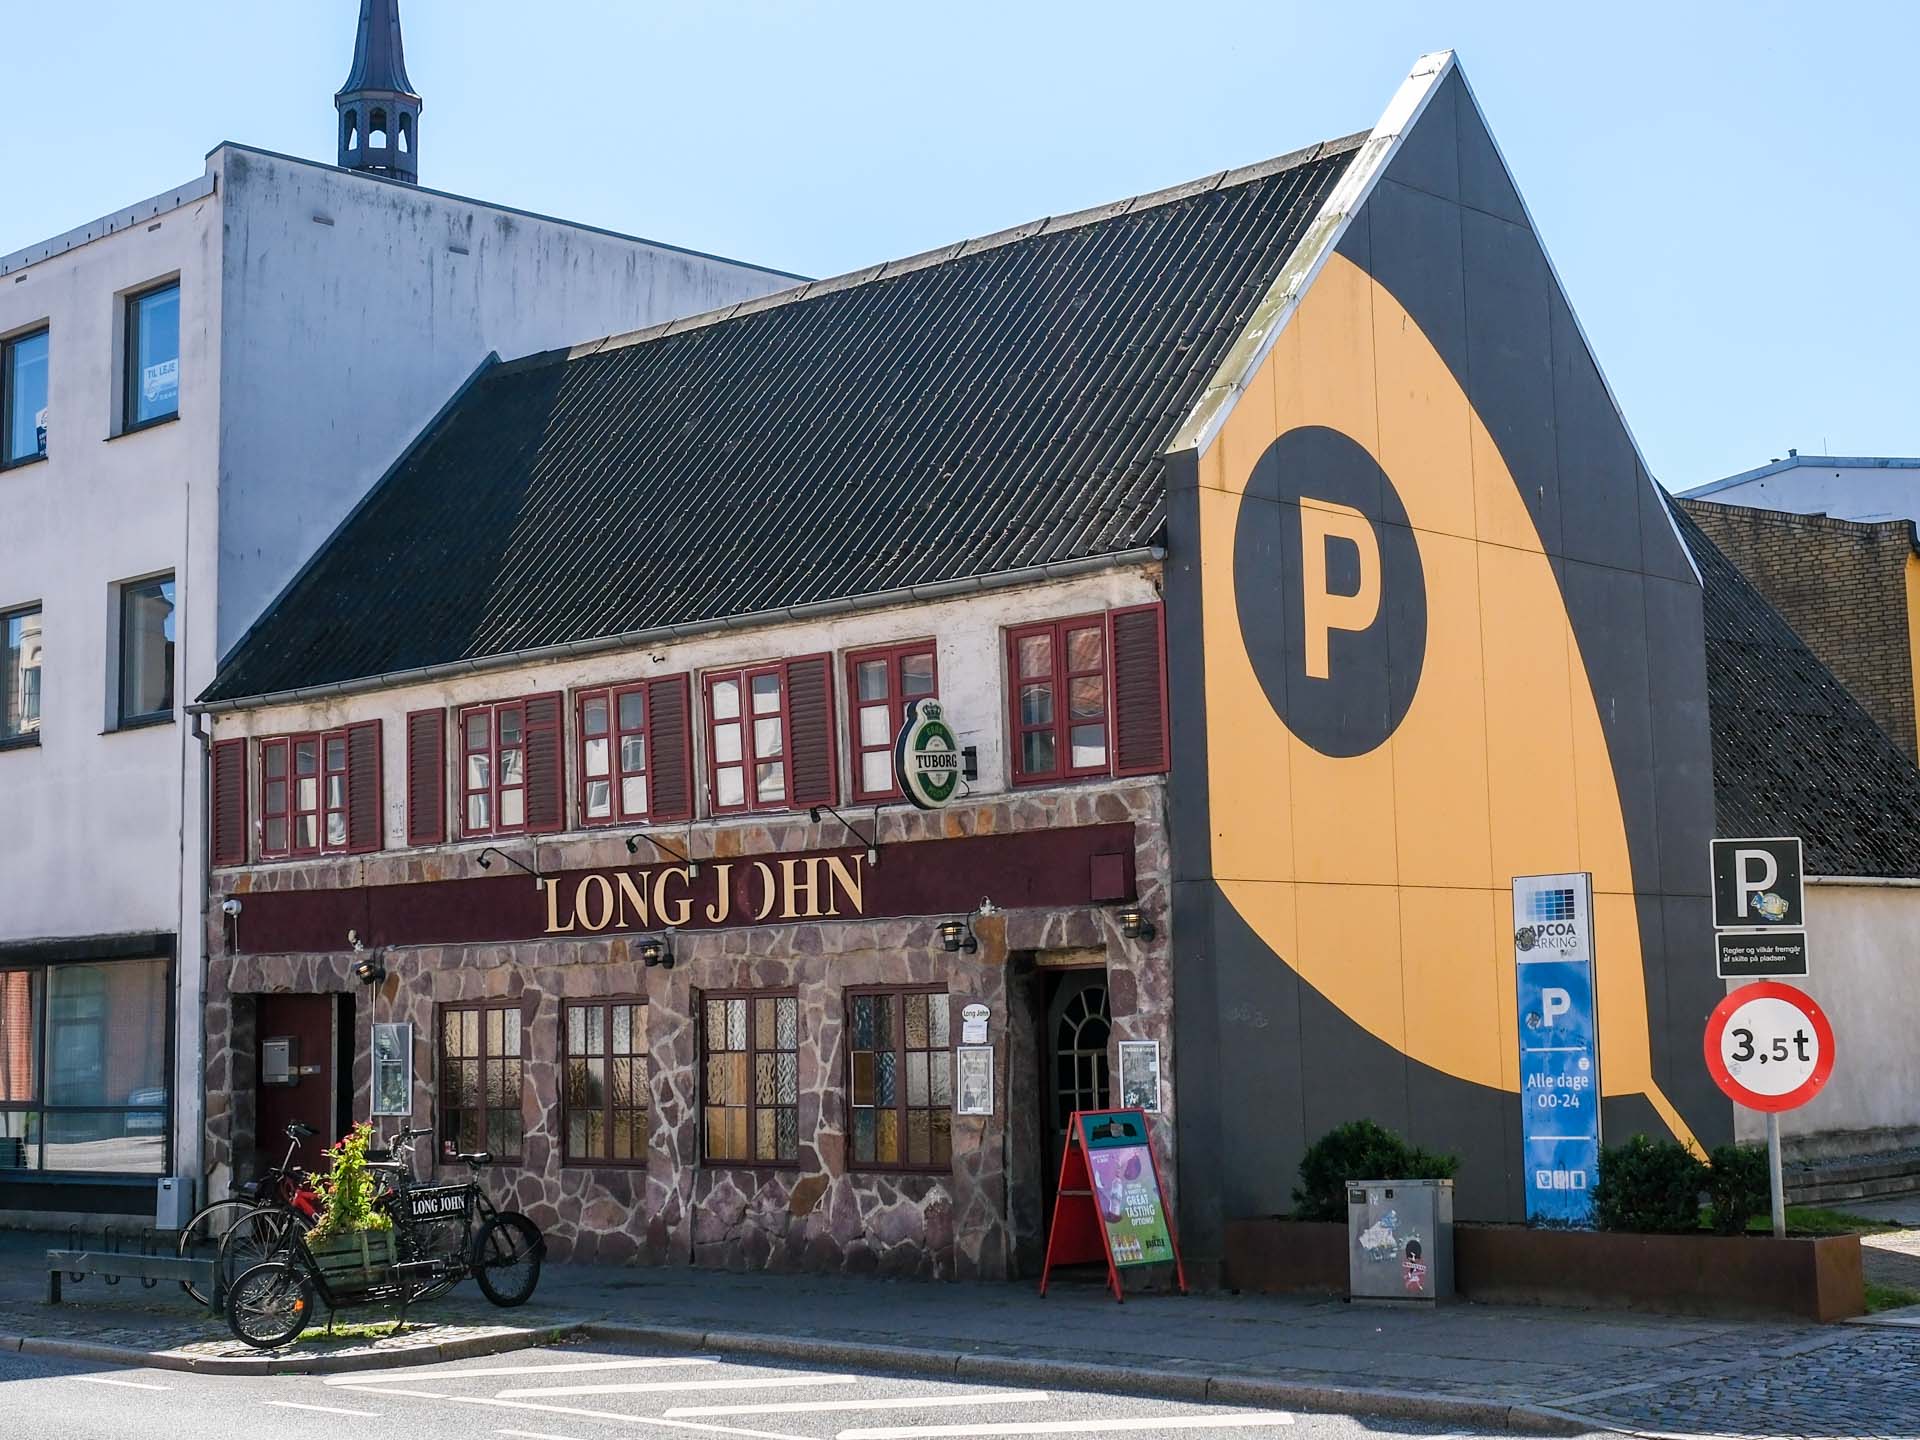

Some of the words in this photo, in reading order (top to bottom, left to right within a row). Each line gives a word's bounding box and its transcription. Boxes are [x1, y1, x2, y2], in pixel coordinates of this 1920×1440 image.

[1299, 495, 1381, 679] P
[916, 754, 958, 769] TUBORG
[1735, 849, 1778, 917] P
[544, 866, 694, 933] LONG
[1533, 937, 1577, 949] ARKING
[1723, 946, 1745, 955] Regler
[1745, 947, 1755, 955] og
[1756, 945, 1773, 953] vilkår
[1774, 945, 1801, 954] fremgår
[1723, 955, 1730, 963] af
[1750, 954, 1759, 963] på
[1760, 954, 1787, 962] pladsen
[963, 1010, 976, 1019] Long
[976, 1009, 989, 1017] John
[1542, 987, 1571, 1027] P
[1527, 1073, 1553, 1088] Alle
[1557, 1072, 1589, 1091] dage
[1538, 1094, 1580, 1108] 00-24
[412, 1199, 438, 1215] LONG
[440, 1196, 465, 1211] JOHN
[1126, 1194, 1150, 1207] GREAT
[1125, 1204, 1156, 1218] TASTING
